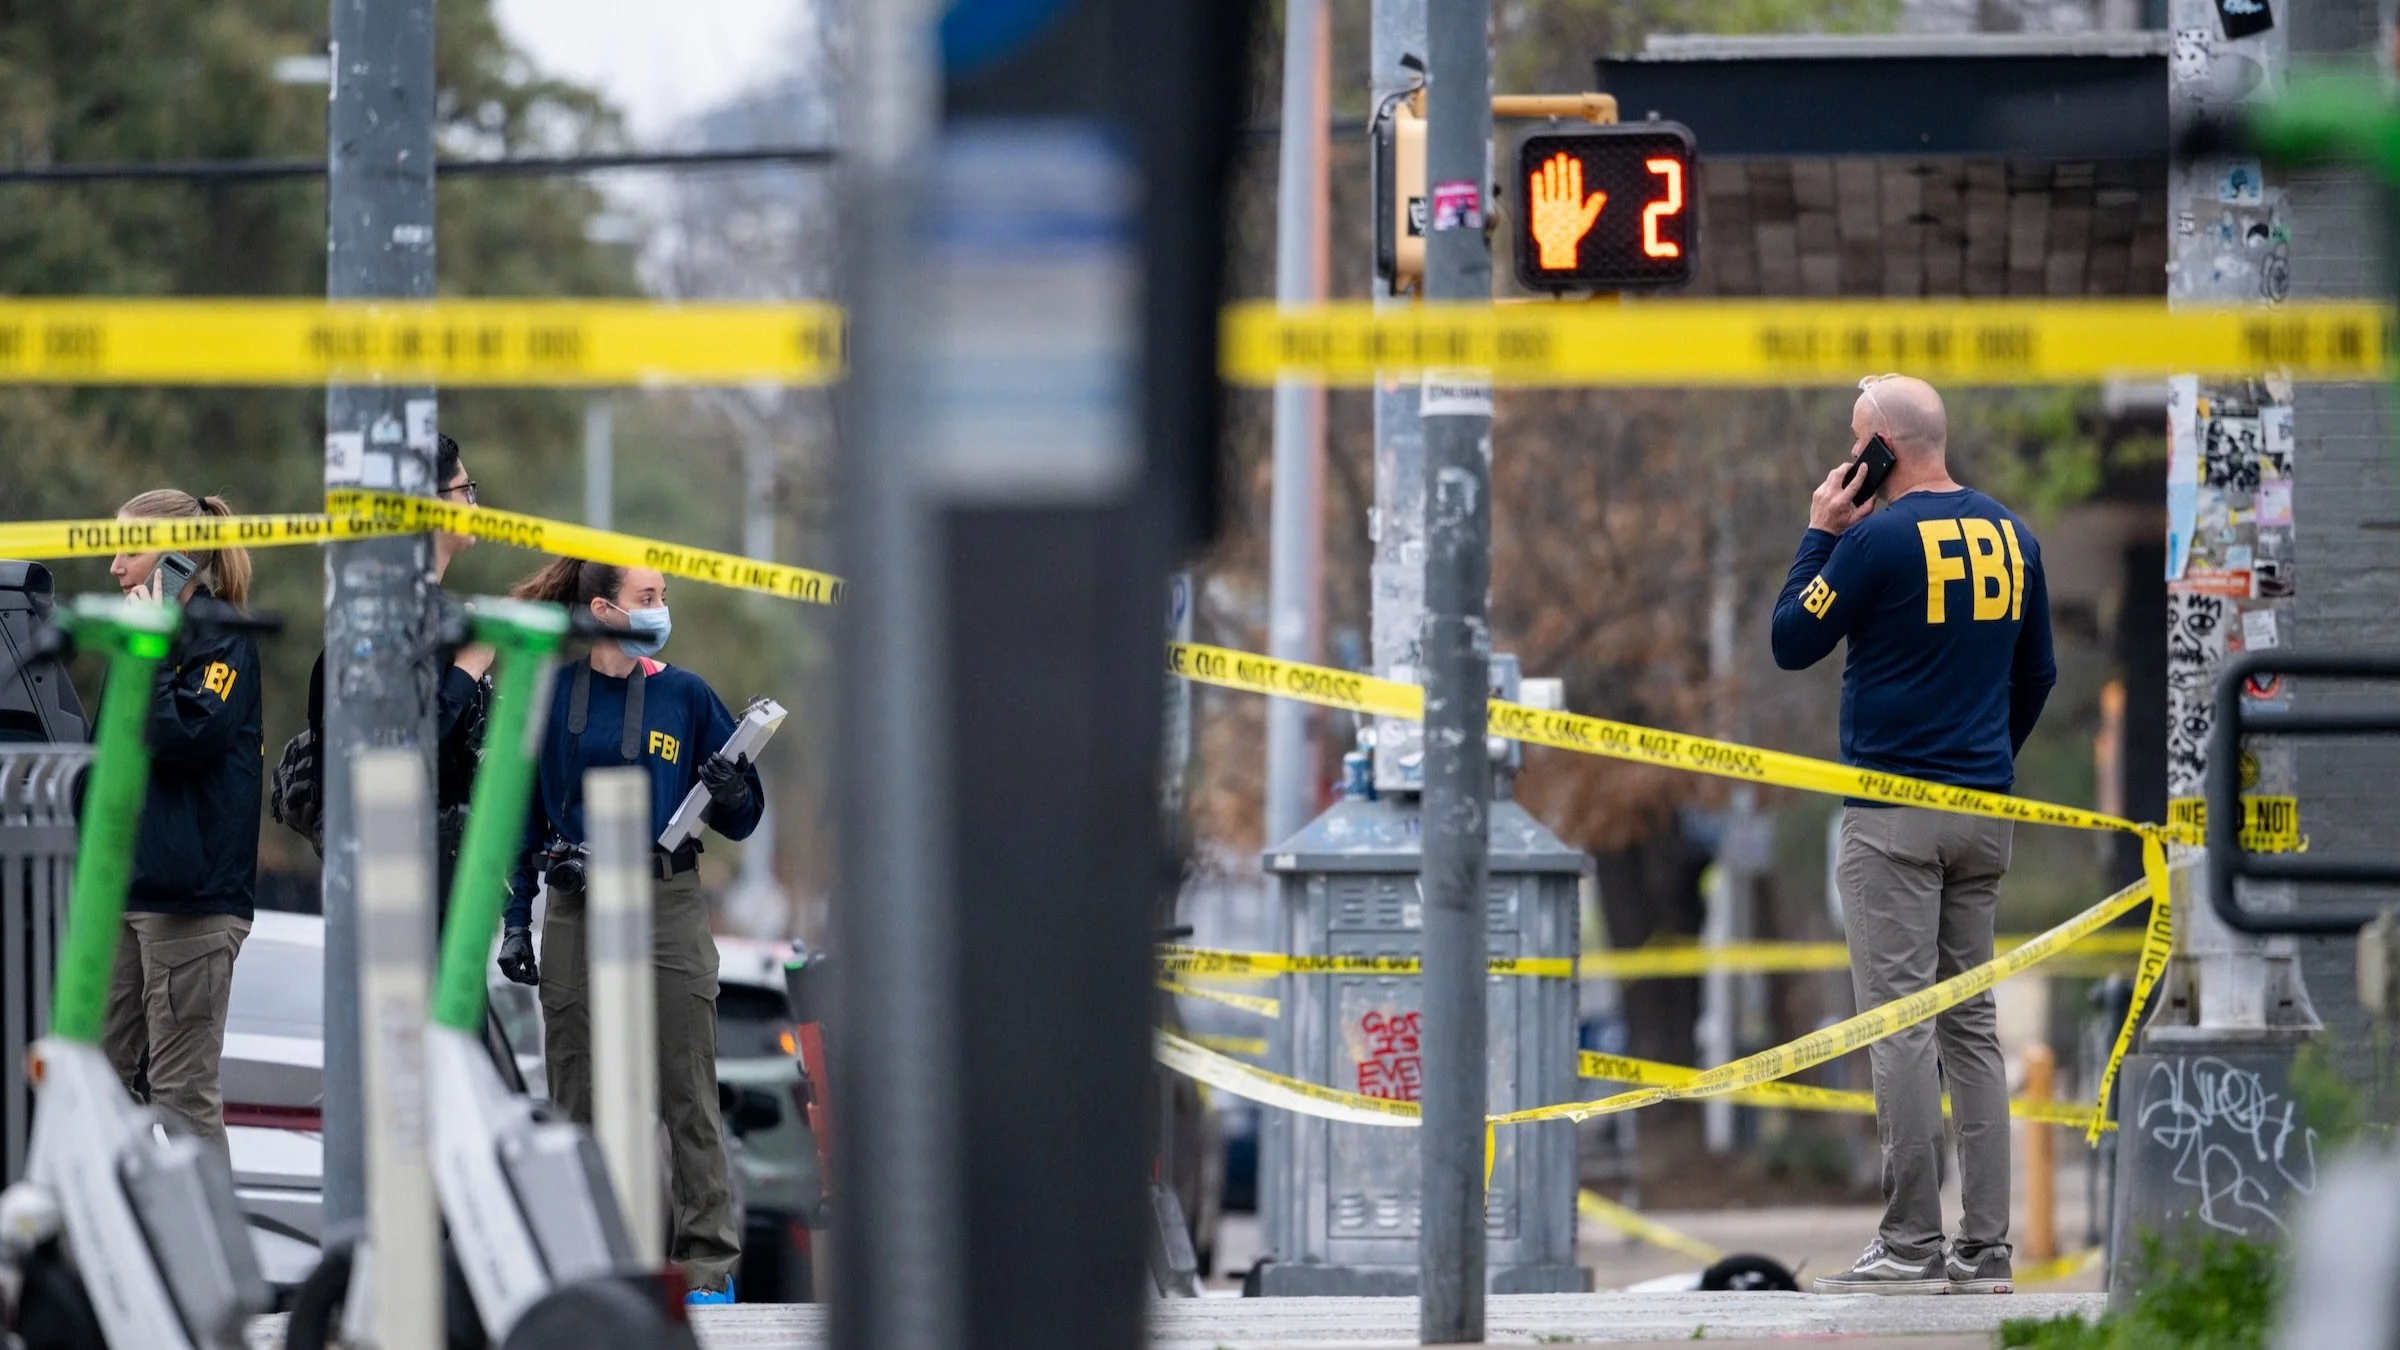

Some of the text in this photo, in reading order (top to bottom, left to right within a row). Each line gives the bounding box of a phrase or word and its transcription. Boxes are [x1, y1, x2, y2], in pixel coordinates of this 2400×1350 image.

[1642, 157, 1683, 258] 2
[68, 524, 159, 549] POLICE
[172, 521, 225, 543] LINE
[239, 519, 272, 538] DO
[286, 516, 332, 536] NOT
[1917, 518, 2024, 624] FBI
[1798, 574, 1838, 620] FBI
[197, 660, 238, 702] BI
[648, 730, 680, 765] FBI
[2256, 801, 2291, 834] NOT
[1357, 1056, 1422, 1088] EVE
